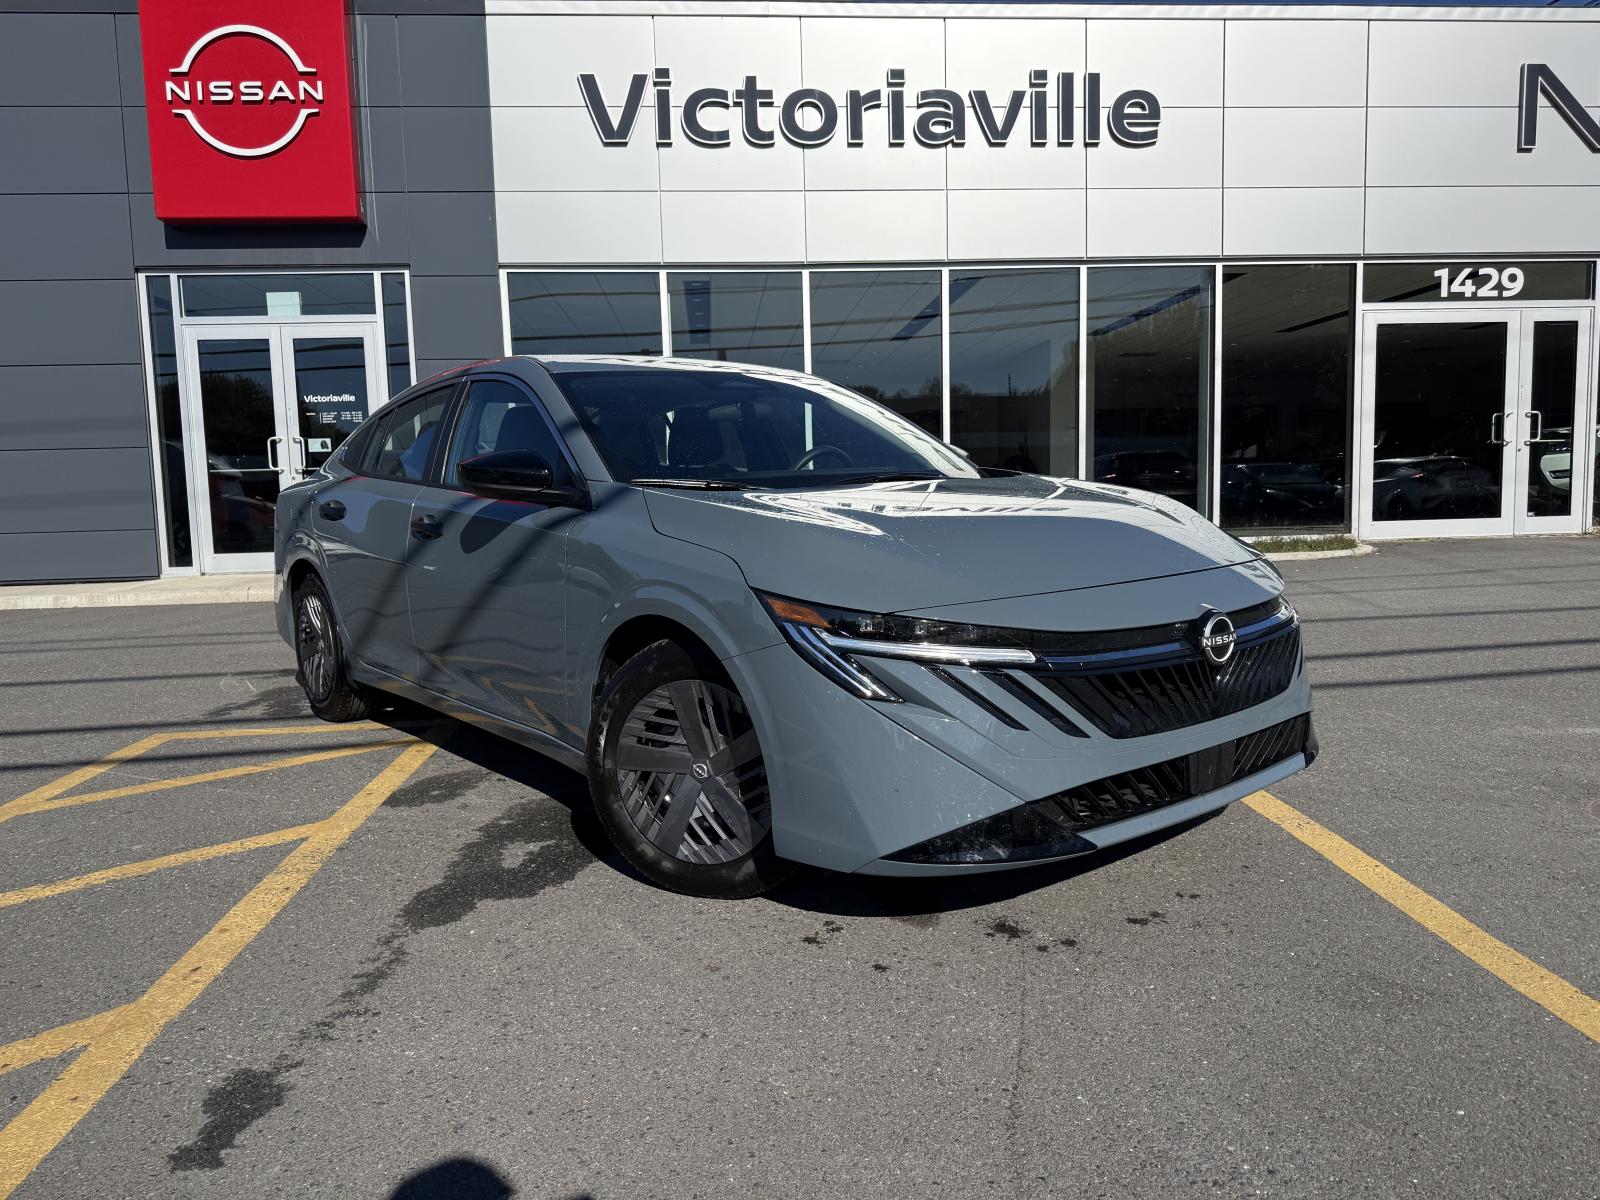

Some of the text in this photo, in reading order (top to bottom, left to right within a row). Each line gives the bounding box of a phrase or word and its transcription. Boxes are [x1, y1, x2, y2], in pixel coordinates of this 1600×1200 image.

[165, 80, 324, 103] NISSAN
[576, 68, 1162, 147] Victoriaville
[1433, 266, 1525, 298] 1429
[303, 394, 356, 402] Victoriaville
[1203, 633, 1237, 646] NISSAN
